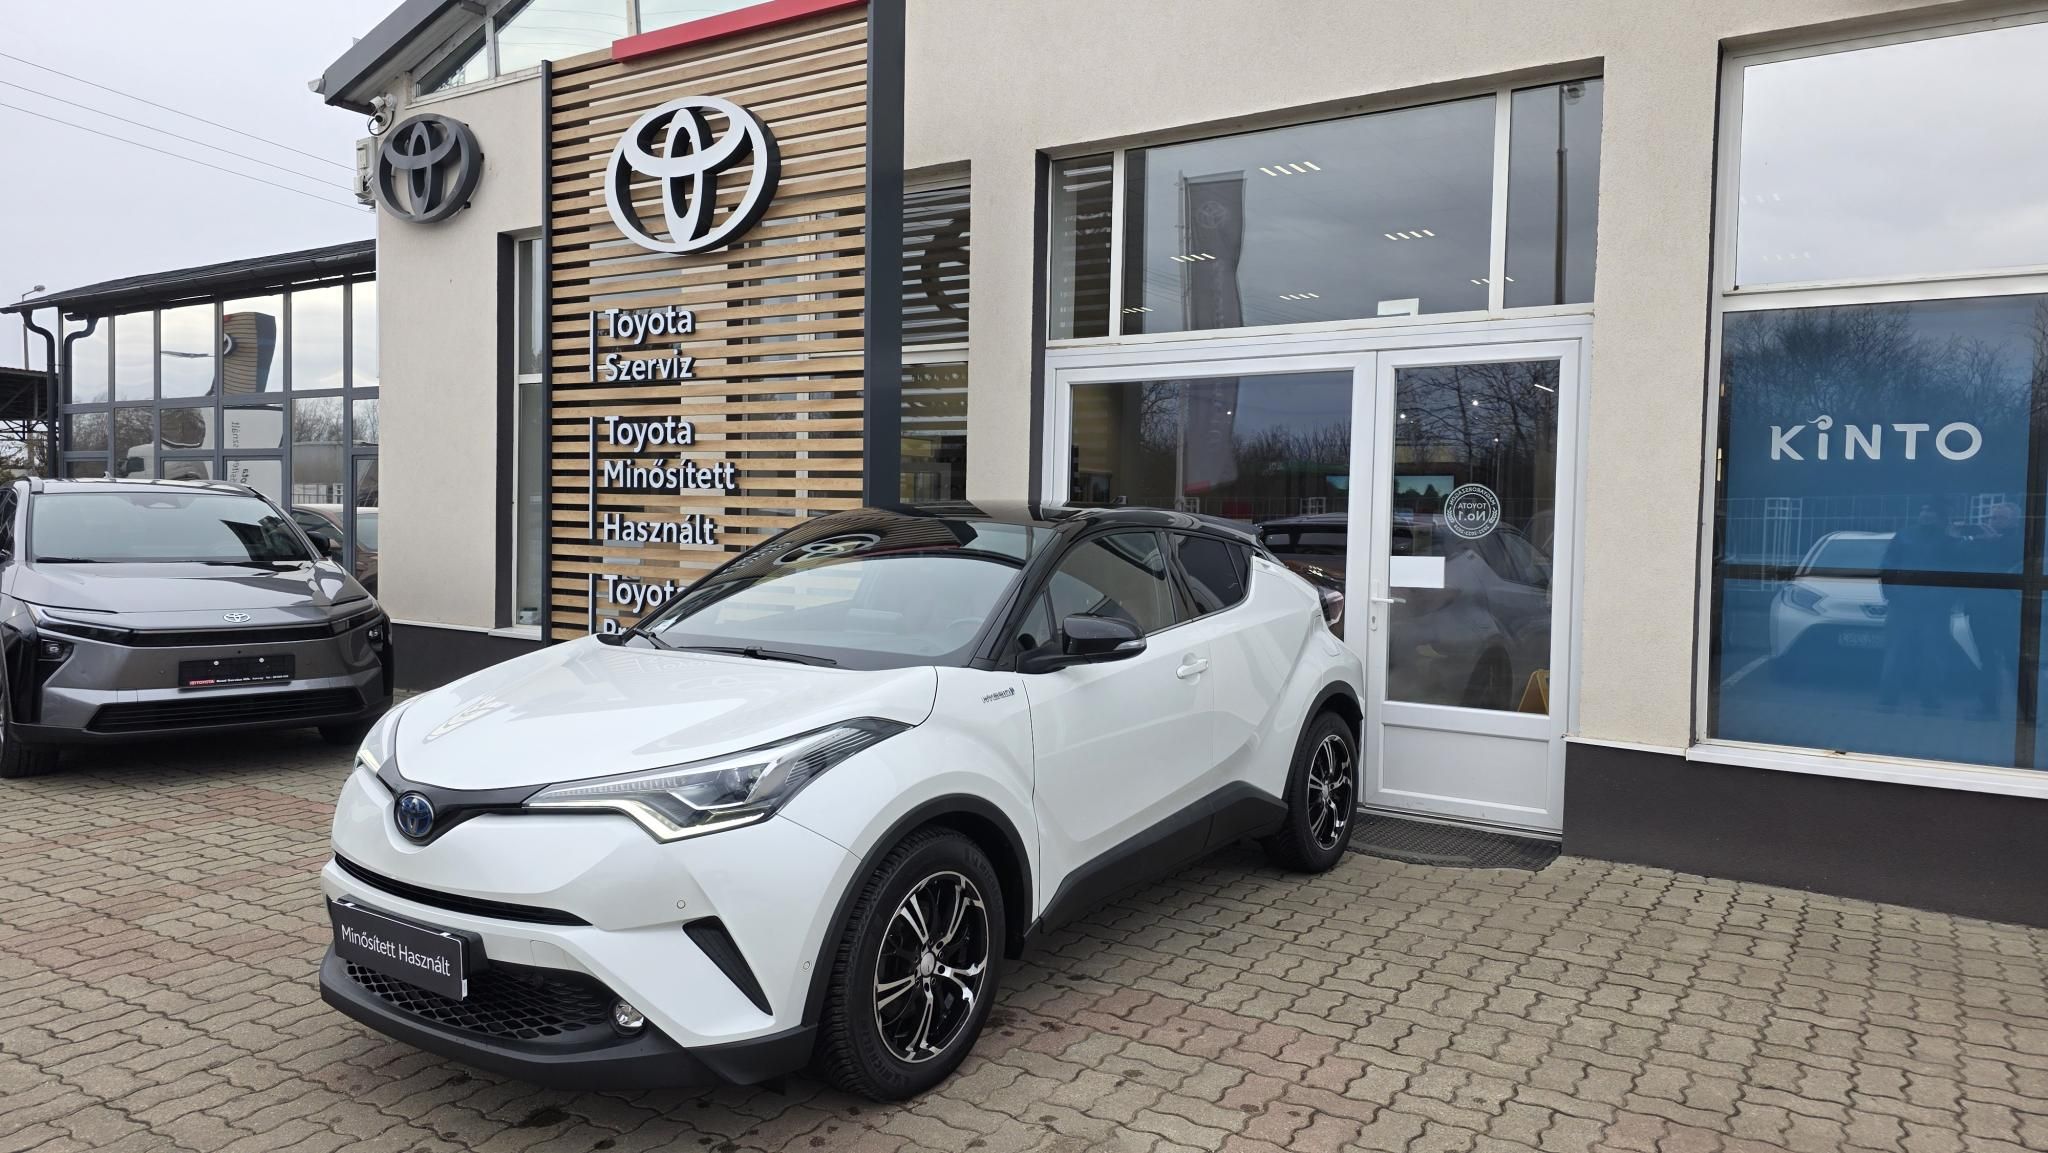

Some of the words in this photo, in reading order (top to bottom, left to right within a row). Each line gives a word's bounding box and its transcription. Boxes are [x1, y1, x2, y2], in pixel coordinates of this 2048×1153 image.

[605, 305, 693, 345] Toyota
[605, 348, 693, 382] Szerviz
[604, 415, 692, 453] Toyota
[603, 459, 736, 490] Minősített
[603, 513, 715, 545] Használt
[341, 923, 396, 959] Minősített
[398, 943, 451, 977] Használt
